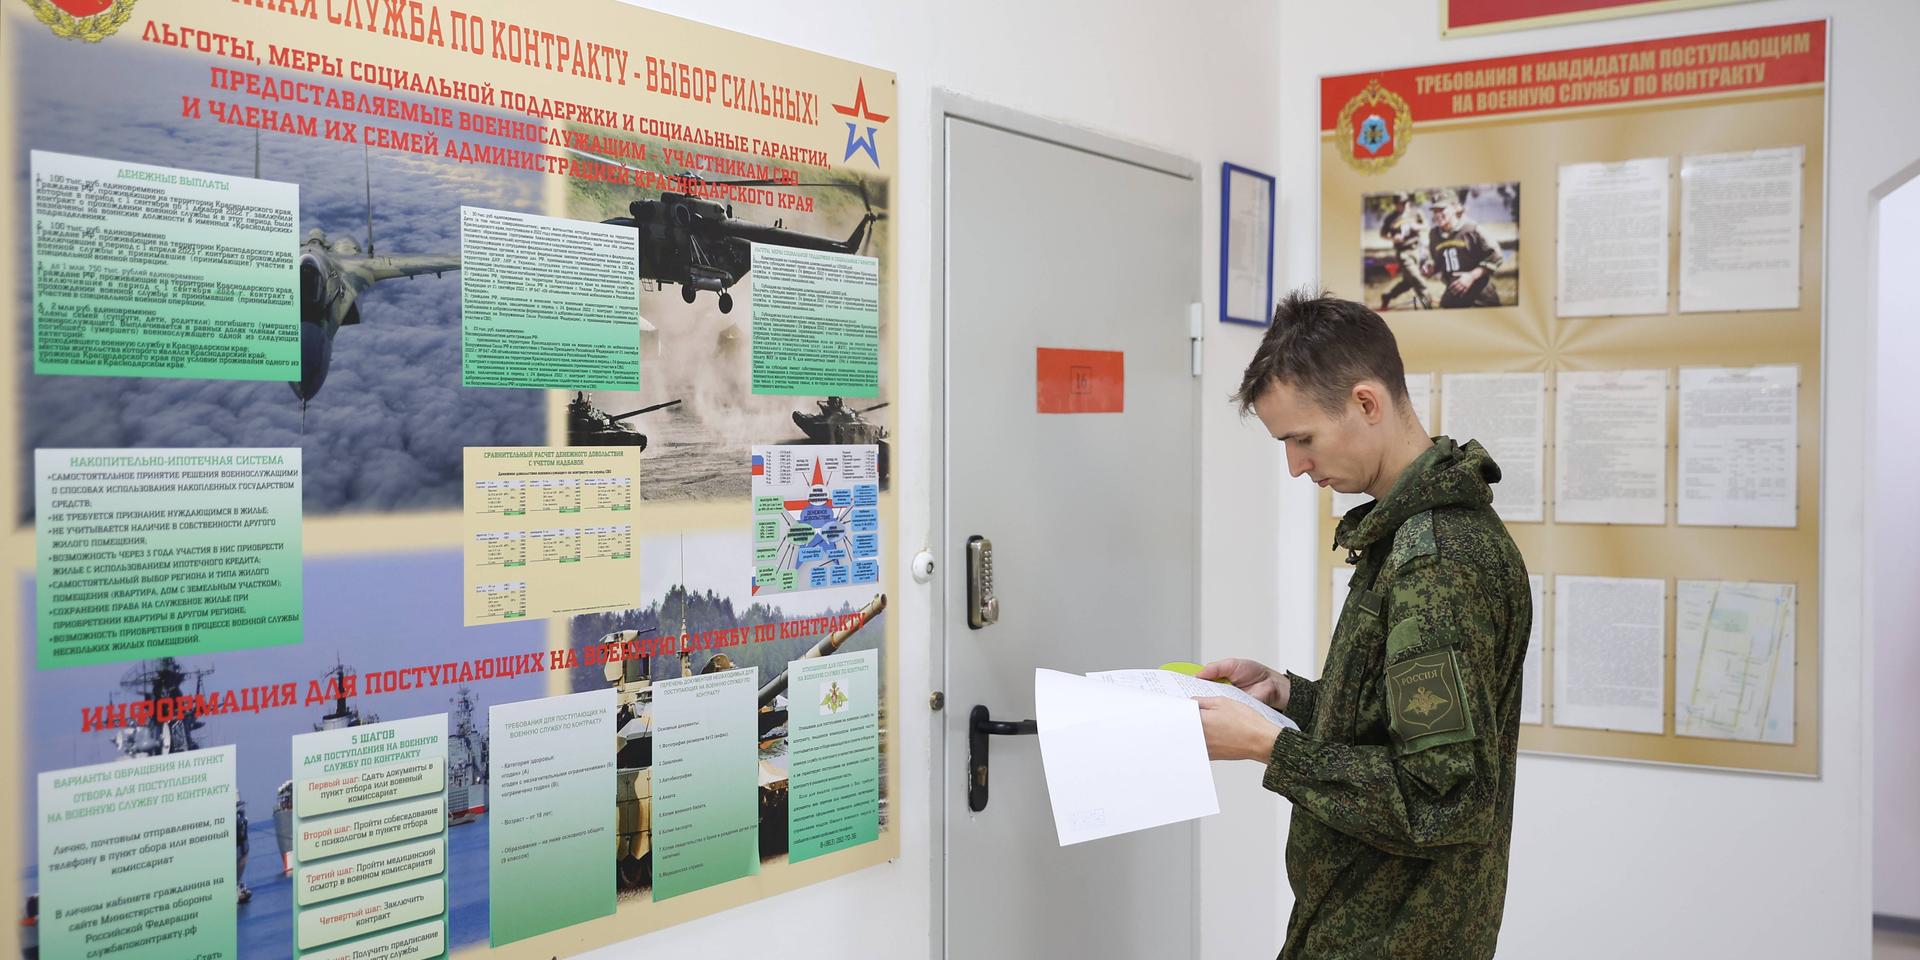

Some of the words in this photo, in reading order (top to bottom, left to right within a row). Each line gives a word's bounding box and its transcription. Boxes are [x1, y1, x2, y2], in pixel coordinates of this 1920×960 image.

[326, 0, 444, 47] СЛУЖБА
[450, 10, 485, 56] ПО
[491, 20, 628, 86] КОНТРАКТУ
[646, 55, 717, 104] ВЫБОР
[722, 72, 819, 126] СИЛЬНЫХ!
[1415, 67, 1517, 95] ТРЕБОВАНИЯ
[1521, 65, 1532, 83] К
[1536, 50, 1655, 82] КАНДИДАТАМ
[1660, 32, 1810, 68] ПОСТУПАЮЩИМ
[142, 20, 261, 66] ЛЬГОТЫ,
[268, 44, 343, 78] МЕРЫ
[351, 61, 495, 106] СОЦИАЛЬНОЙ
[500, 90, 618, 127] ПОДДЕРЖКИ
[622, 114, 635, 132] И
[639, 117, 749, 153] СОЦИАЛЬНЫЕ
[752, 139, 832, 171] ГАРАНТИИ,
[1452, 93, 1473, 114] НА
[1476, 85, 1554, 112] ВОЕННУЮ
[1559, 78, 1629, 103] СЛУЖБУ
[1634, 74, 1657, 95] ПО
[1661, 64, 1765, 92] КОНТРАКТУ
[210, 67, 454, 129] ПРЕДОСТАВЛЯЕМЫЕ
[459, 111, 646, 161] ВОЕННОСЛУЖАЩИМ
[662, 147, 769, 181] УЧАСТНИКАМ
[772, 167, 799, 186] СВО
[182, 96, 200, 119] И
[208, 100, 318, 138] ЧЛЕНАМ
[324, 119, 357, 143] ИХ
[364, 126, 439, 156] СЕМЕЙ
[444, 139, 630, 185] АДМИНИСТРАЦИЕЙ
[635, 169, 773, 206] КРАСНОДАРСКОГО
[777, 192, 814, 213] КРАЯ
[117, 169, 177, 184] ДЕНЕЖНЫЕ
[180, 176, 229, 190] ВЫПЛАТЫ
[1443, 247, 1460, 272] 16
[52, 472, 134, 481] САМОСТОЯТЕЛЬНОЕ
[137, 471, 179, 479] ПРИНЯТИЕ
[182, 470, 219, 479] РЕШЕНИЯ
[221, 469, 298, 477] ВОЕННОСЛУЖАЩИМИ
[70, 455, 233, 466] НАКОПИТЕЛЬНО-ИПОТЕЧНАЯ
[236, 455, 284, 465] СИСТЕМА
[59, 486, 103, 494] СПОСОБАХ
[106, 485, 175, 493] ИСПОЛЬЗОВАНИЯ
[178, 483, 236, 491] НАКОПЛЕННЫХ
[239, 482, 294, 490] ГОСУДАРСТВОМ
[52, 500, 91, 508] СРЕДСТВ;
[67, 511, 114, 521] ТРЕБУЕТСЯ
[116, 510, 165, 519] ПРИЗНАНИЕ
[168, 508, 231, 518] НУЖДАЮЩИМСЯ
[240, 507, 268, 515] ЖИЛЬЕ;
[80, 682, 297, 733] ИНФОРМАЦИЯ
[303, 675, 357, 707] ДЛЯ
[365, 652, 544, 695] ПОСТУПАЮЩИХ
[550, 648, 577, 670] НА
[584, 634, 676, 666] ВОЕННУЮ
[679, 627, 749, 654] СЛУЖБУ
[754, 624, 775, 643] ПО
[779, 613, 867, 640] КОНТРАКТУ
[1401, 669, 1438, 686] РОССИЯ
[304, 754, 321, 765] ДЛЯ
[324, 745, 384, 761] ПОСТУПЛЕНИЯ
[387, 742, 398, 750] НА
[400, 736, 438, 749] ВОЕННУЮ
[352, 736, 357, 744] 5
[360, 729, 394, 743] ШАГОВ
[54, 771, 111, 788] ВАРИАНТЫ
[115, 762, 175, 780] ОБРАЩЕНИЯ
[178, 759, 191, 768] НА
[193, 754, 224, 766] ПУНКТ
[324, 760, 359, 772] СЛУЖБУ
[361, 758, 372, 766] ПО
[374, 750, 420, 764] КОНТРАКТУ
[73, 790, 112, 803] ОТБОРА
[115, 784, 136, 797] ДЛЯ
[138, 773, 207, 792] ПОСТУПЛЕНИЯ
[309, 779, 340, 791] Первый
[343, 776, 359, 786] шаг:
[362, 771, 384, 781] Сдать
[386, 765, 427, 778] документы
[321, 788, 343, 800] пункт
[346, 784, 372, 794] отбора
[390, 774, 422, 786] военный
[48, 811, 62, 823] НА
[65, 803, 115, 820] ВОЕННУЮ
[119, 796, 159, 811] СЛУЖБУ
[162, 794, 174, 803] ПО
[177, 784, 229, 801] КОНТРАКТУ
[348, 789, 397, 803] комиссариат
[54, 844, 88, 856] Лично,
[91, 832, 140, 848] почтовым
[143, 821, 212, 840] отправлением,
[215, 817, 224, 826] по
[304, 827, 332, 840] Второй
[334, 824, 352, 834] шаг:
[354, 818, 381, 830] Пройти
[384, 808, 438, 824] собеседование
[321, 832, 367, 847] психологом
[376, 825, 401, 837] пункте
[403, 819, 428, 830] отбора
[49, 856, 97, 872] телефону
[109, 848, 136, 862] пункт
[139, 840, 166, 854] обора
[170, 838, 187, 847] или
[189, 830, 229, 845] военный
[111, 856, 174, 875] комиссариат
[307, 870, 335, 883] Третий
[337, 868, 354, 878] шаг:
[357, 860, 384, 872] Пройти
[387, 848, 436, 865] медицинский
[310, 881, 338, 892] осмотр
[347, 871, 380, 883] военном
[382, 858, 433, 875] комиссариате
[320, 911, 363, 924] Четвертый
[365, 905, 382, 915] шаг:
[384, 895, 424, 909] Заключить
[356, 911, 390, 926] контракт
[85, 924, 142, 944] Российской
[146, 911, 198, 932] Федерации
[87, 925, 197, 958] службапоконтракту.рф
[391, 931, 438, 951] предписание
